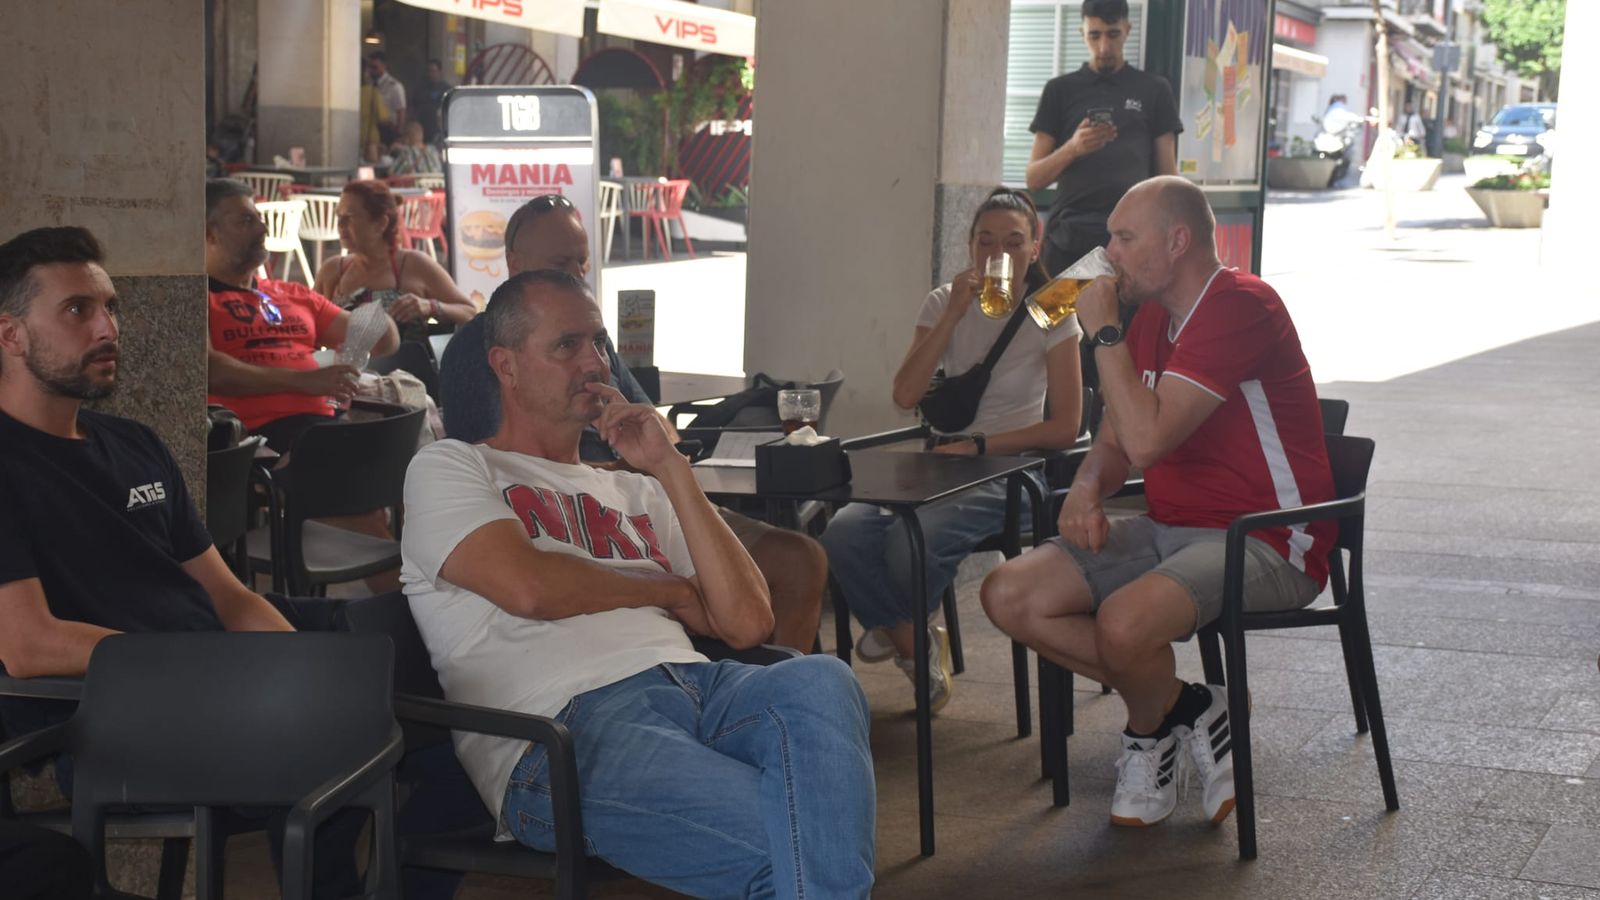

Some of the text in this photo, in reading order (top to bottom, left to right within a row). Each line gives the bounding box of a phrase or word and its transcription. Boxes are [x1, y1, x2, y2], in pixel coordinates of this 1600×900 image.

[656, 14, 717, 44] VIPS
[497, 95, 540, 131] TGB
[471, 163, 574, 185] MANIA
[223, 324, 309, 342] BULLONES
